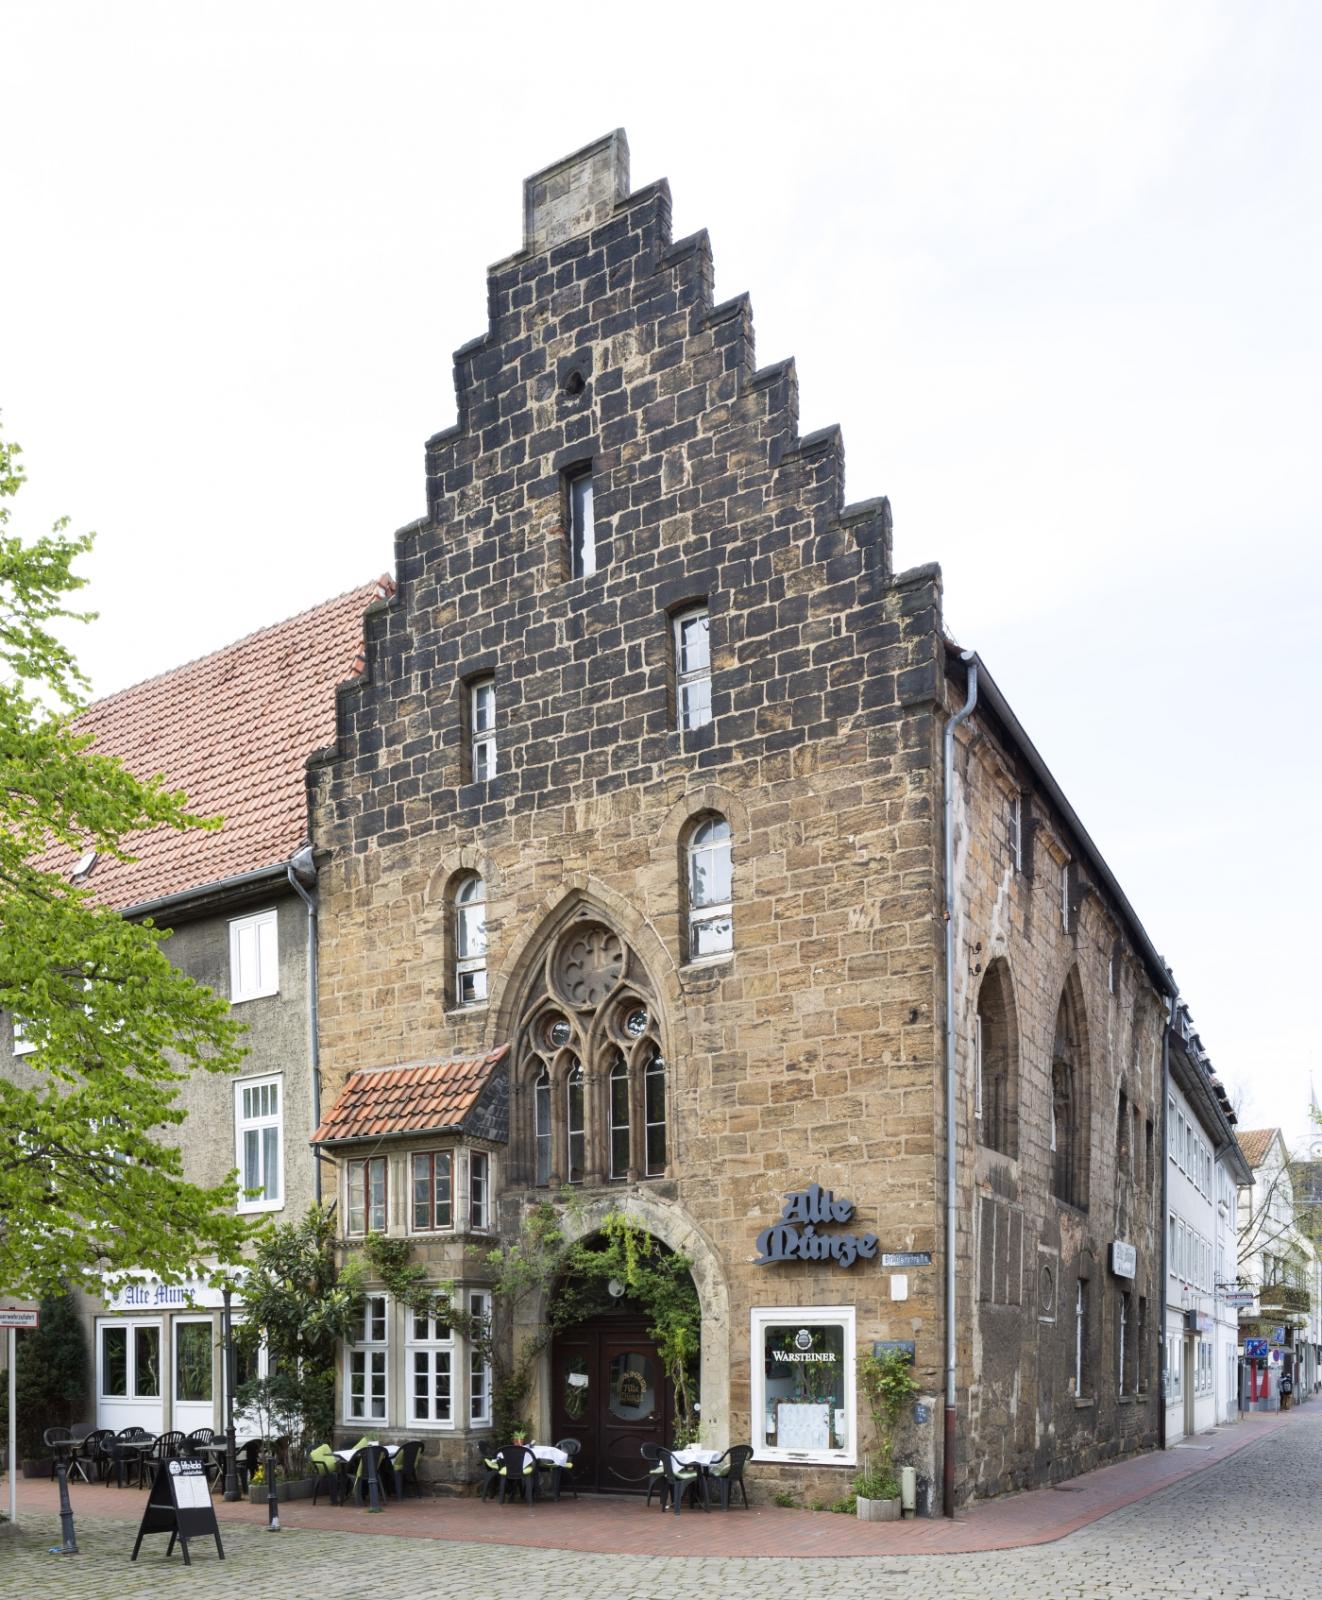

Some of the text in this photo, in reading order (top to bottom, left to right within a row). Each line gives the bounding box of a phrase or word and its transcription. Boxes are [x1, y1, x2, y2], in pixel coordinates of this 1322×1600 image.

[776, 1183, 853, 1224] Alte
[125, 1285, 150, 1304] Alte
[772, 1350, 837, 1363] WARSTEINER
